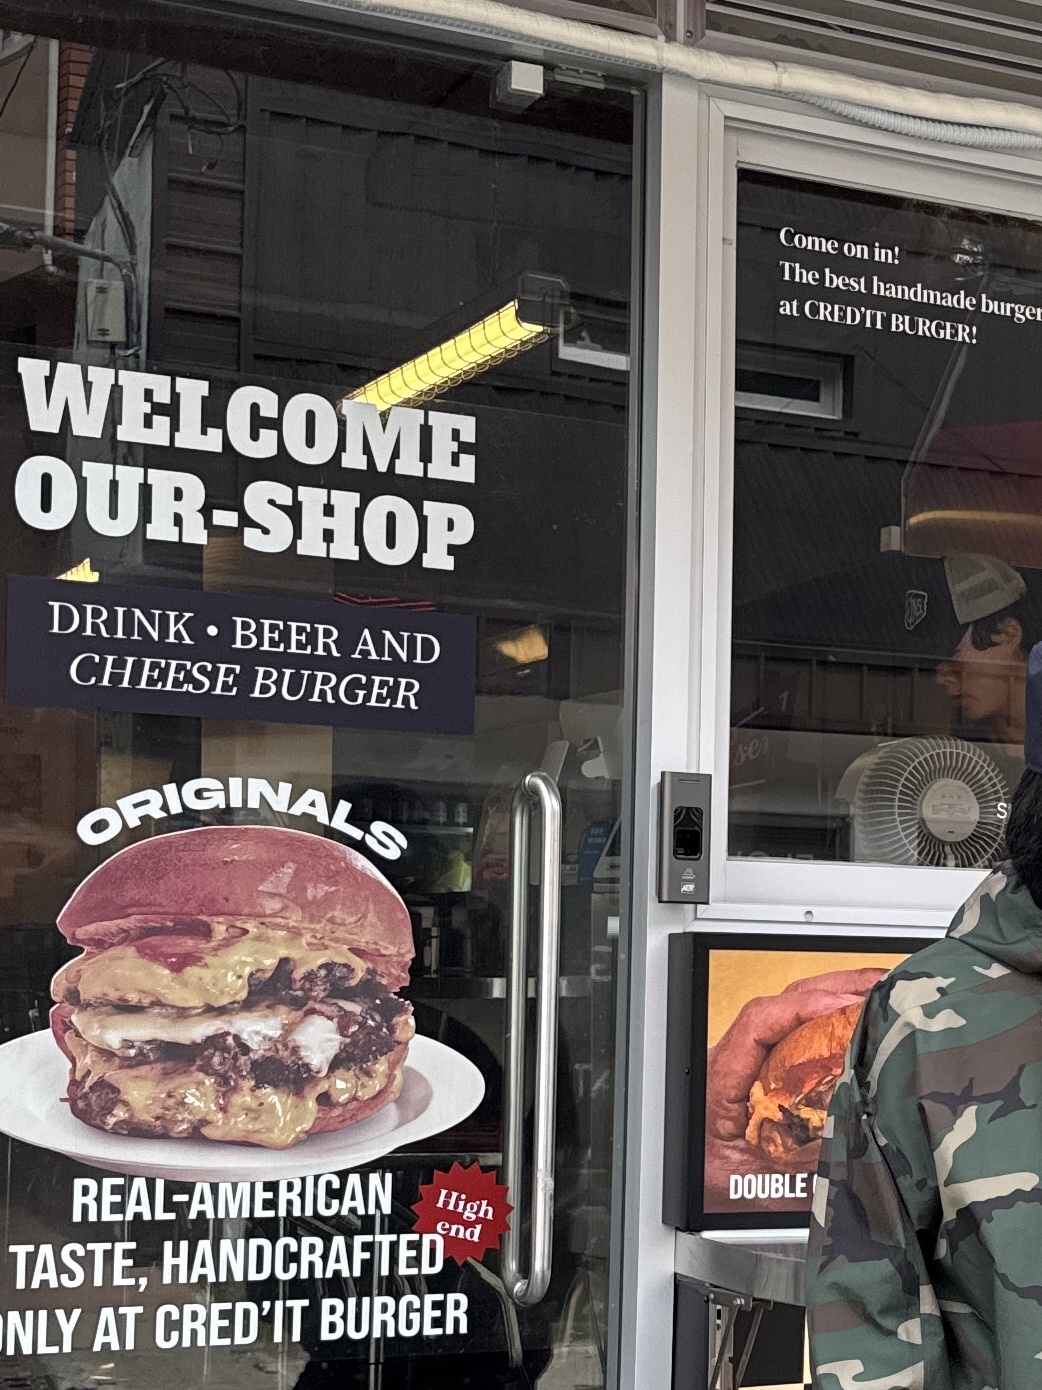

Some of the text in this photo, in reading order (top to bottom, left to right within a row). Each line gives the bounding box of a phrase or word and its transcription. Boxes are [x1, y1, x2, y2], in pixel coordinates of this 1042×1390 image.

[779, 227, 900, 264] Come on in!
[779, 260, 820, 285] The
[824, 262, 868, 294] best
[872, 275, 977, 311] handmade
[779, 299, 800, 317] at
[890, 312, 978, 344] BURGER!
[17, 357, 476, 483] WELCOME
[14, 455, 475, 571] OUR-SHOP
[47, 601, 442, 665] DRINK BEER AND
[69, 651, 420, 711] CHEESE BURGER
[76, 777, 409, 862] ORIGINALS
[72, 1172, 394, 1224] REAL-AMERICAN
[436, 1188, 495, 1225] High
[729, 1173, 808, 1200] DOUBLE
[436, 1217, 482, 1244] end
[9, 1233, 445, 1293] TASTE, HANDCRAFTED
[0, 1293, 469, 1356] NLY AT CRED'IT BURGER
